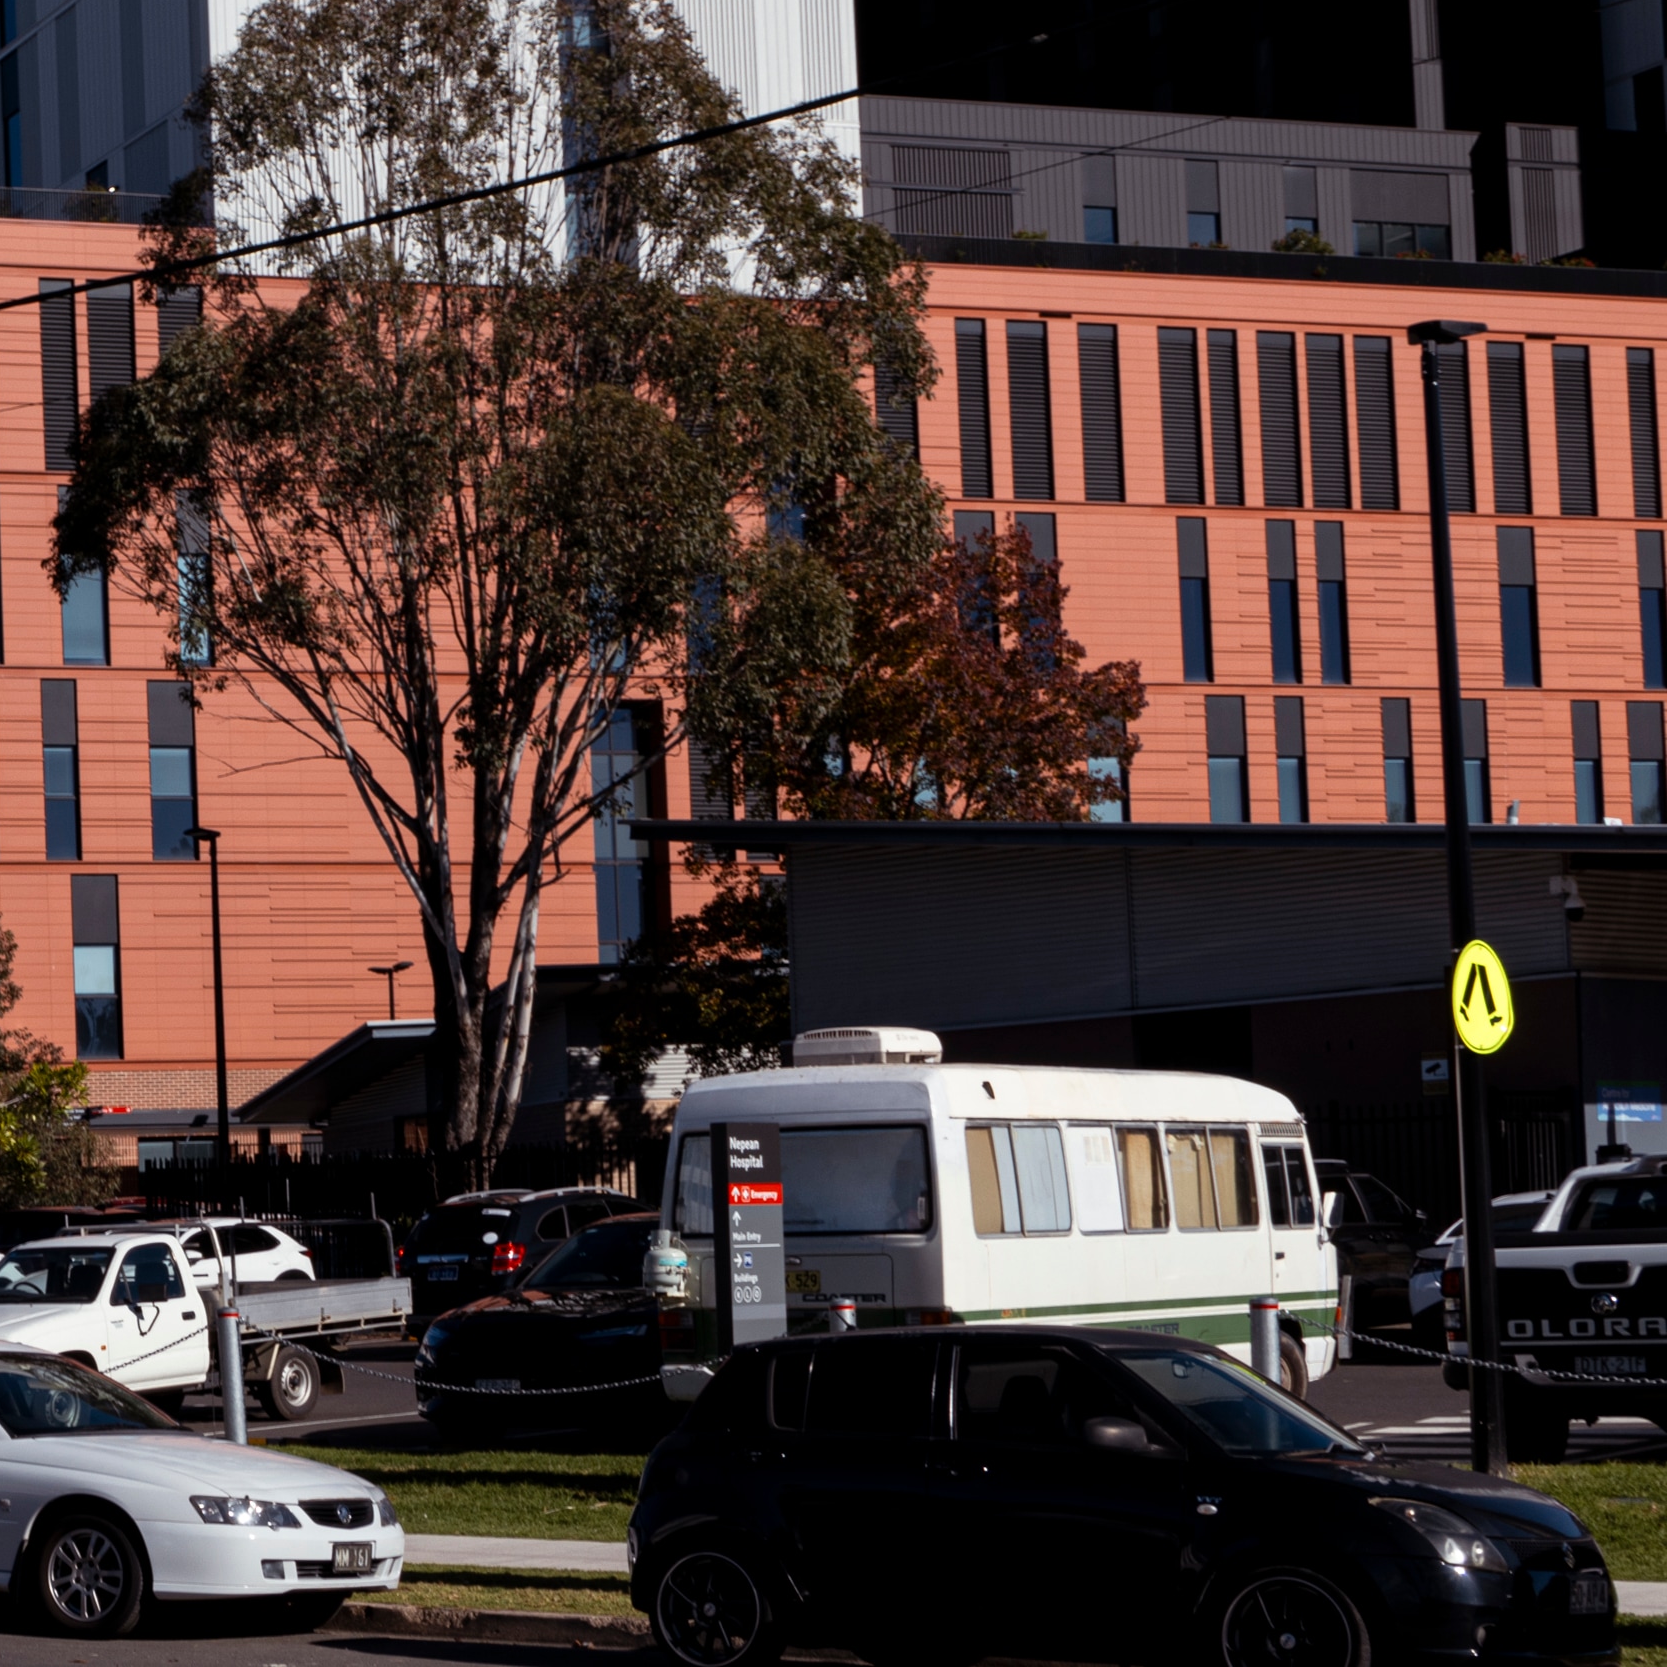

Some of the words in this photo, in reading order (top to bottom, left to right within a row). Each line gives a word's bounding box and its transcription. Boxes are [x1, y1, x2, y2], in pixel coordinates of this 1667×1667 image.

[729, 1136, 760, 1154] Nepean
[730, 1154, 764, 1172] Hospital
[751, 1189, 778, 1201] Emergency
[1127, 1323, 1179, 1334] ASTER
[1507, 1317, 1667, 1337] OLORA
